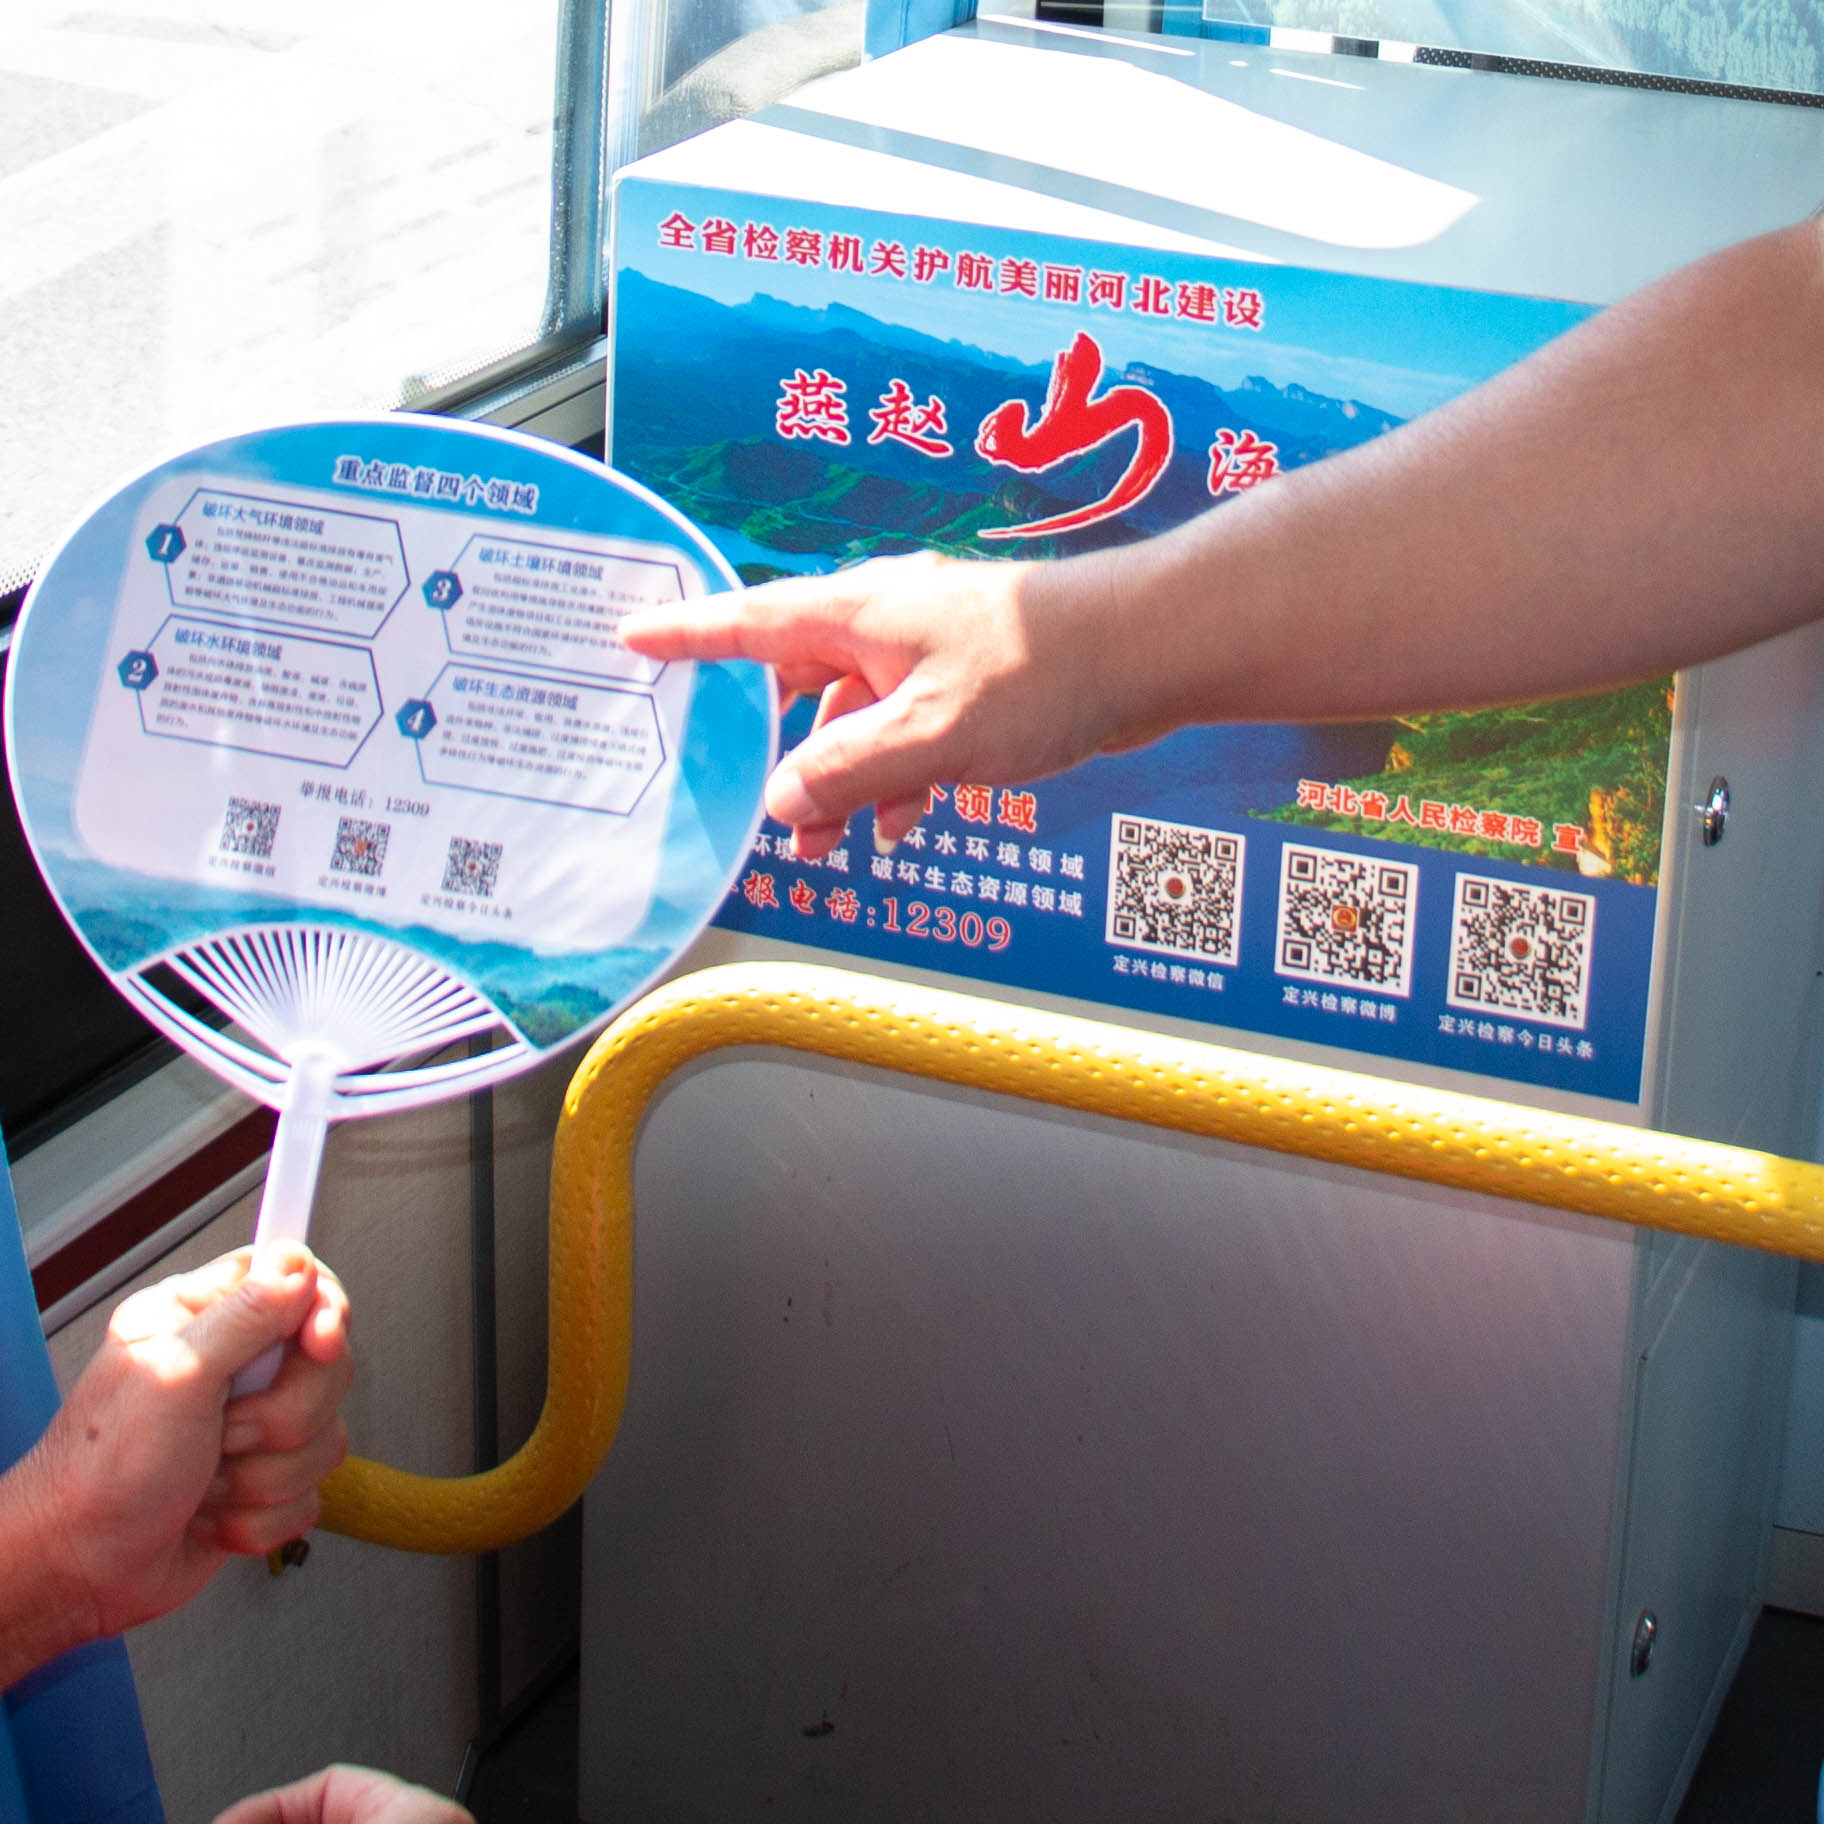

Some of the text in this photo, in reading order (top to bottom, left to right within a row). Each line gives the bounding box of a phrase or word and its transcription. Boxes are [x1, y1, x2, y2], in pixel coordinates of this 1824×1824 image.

[658, 212, 1266, 331] 全省检察机关护航美丽河北建设
[337, 456, 537, 512] 重点监督四个领域
[201, 500, 325, 536] 破坏大气环境领域
[158, 533, 173, 556] 1
[478, 546, 604, 581] 破坏土壤环境领域
[432, 578, 452, 603] 3
[173, 627, 283, 661] 破坏水环境领域
[127, 658, 148, 683] 2
[452, 676, 579, 711] 破坏生态资源领域
[406, 707, 426, 733] 4
[1296, 779, 1584, 853] 河北省人民检察院 宣
[870, 855, 1083, 917] 破坏生态资源领域
[1112, 953, 1226, 991] 定兴检察微信
[1281, 985, 1398, 1024] 定兴检察微博
[1437, 1012, 1596, 1060] 定兴检察今日头条
